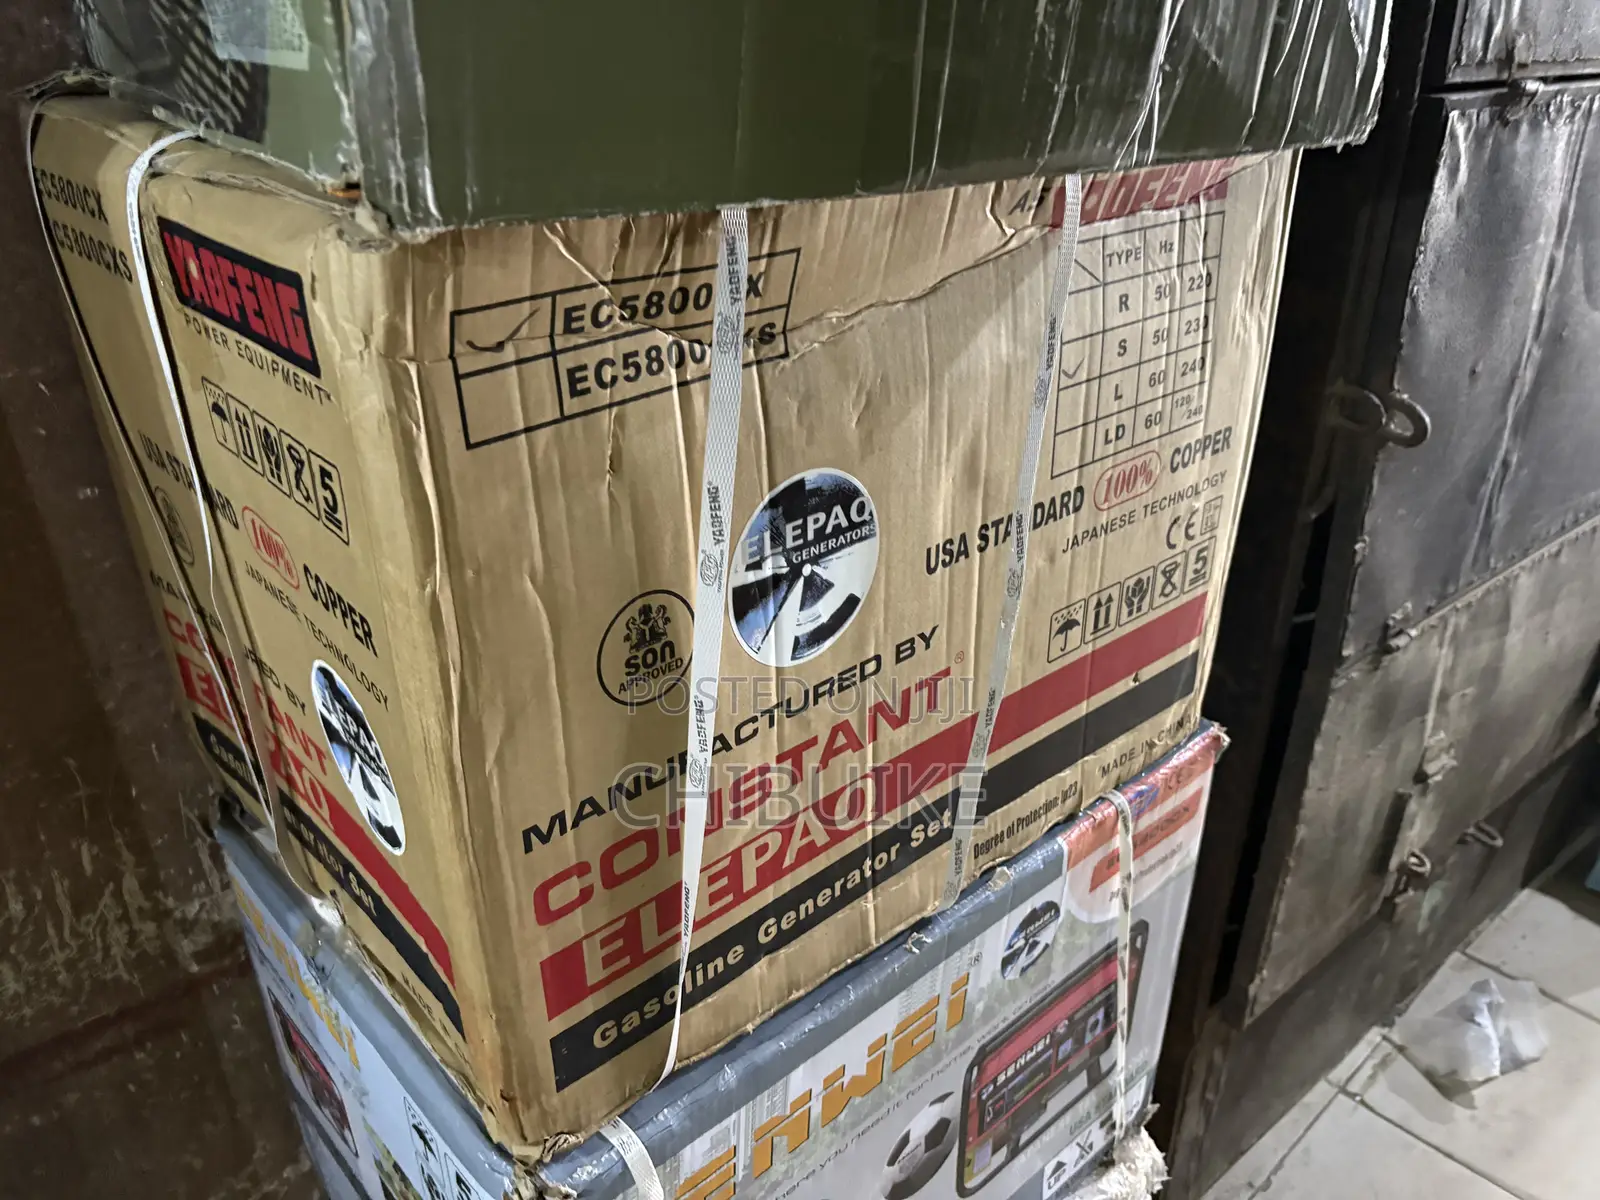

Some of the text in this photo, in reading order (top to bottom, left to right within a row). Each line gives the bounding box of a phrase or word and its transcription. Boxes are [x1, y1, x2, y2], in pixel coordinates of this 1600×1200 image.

[51, 220, 133, 283] C5800CXS
[1106, 240, 1174, 268] TYPE Hz
[164, 231, 313, 361] YAOFENG
[563, 272, 764, 335] EC5800X
[1118, 271, 1213, 313] R 50 220
[185, 313, 327, 405] POWER EQUIPMENT
[566, 322, 777, 399] EC5800S
[1116, 315, 1209, 357] S 50 230
[1113, 355, 1206, 401] L 60 240
[1103, 423, 1126, 446] LD
[1144, 411, 1162, 430] 60
[707, 485, 725, 546] YAOFENG
[739, 496, 873, 568] ELEPAQ
[925, 426, 1233, 576] USA STADARD 100% COPPER
[1062, 510, 1137, 553] JAPANESE
[1142, 470, 1228, 520] TECHNOLOGY
[792, 523, 877, 564] GENERATORS
[303, 562, 379, 659] COPPER
[303, 612, 389, 712] TECHNOLOGY
[617, 656, 684, 695] APPROVED
[895, 625, 940, 665] BY
[284, 683, 306, 716] BY
[1100, 747, 1136, 779] MADE
[533, 666, 952, 927] CONSTANT
[973, 829, 1005, 860] Degree
[1006, 818, 1015, 839] of
[582, 775, 879, 989] ELEPAQ
[593, 808, 953, 1050] Gasoline Generator Set
